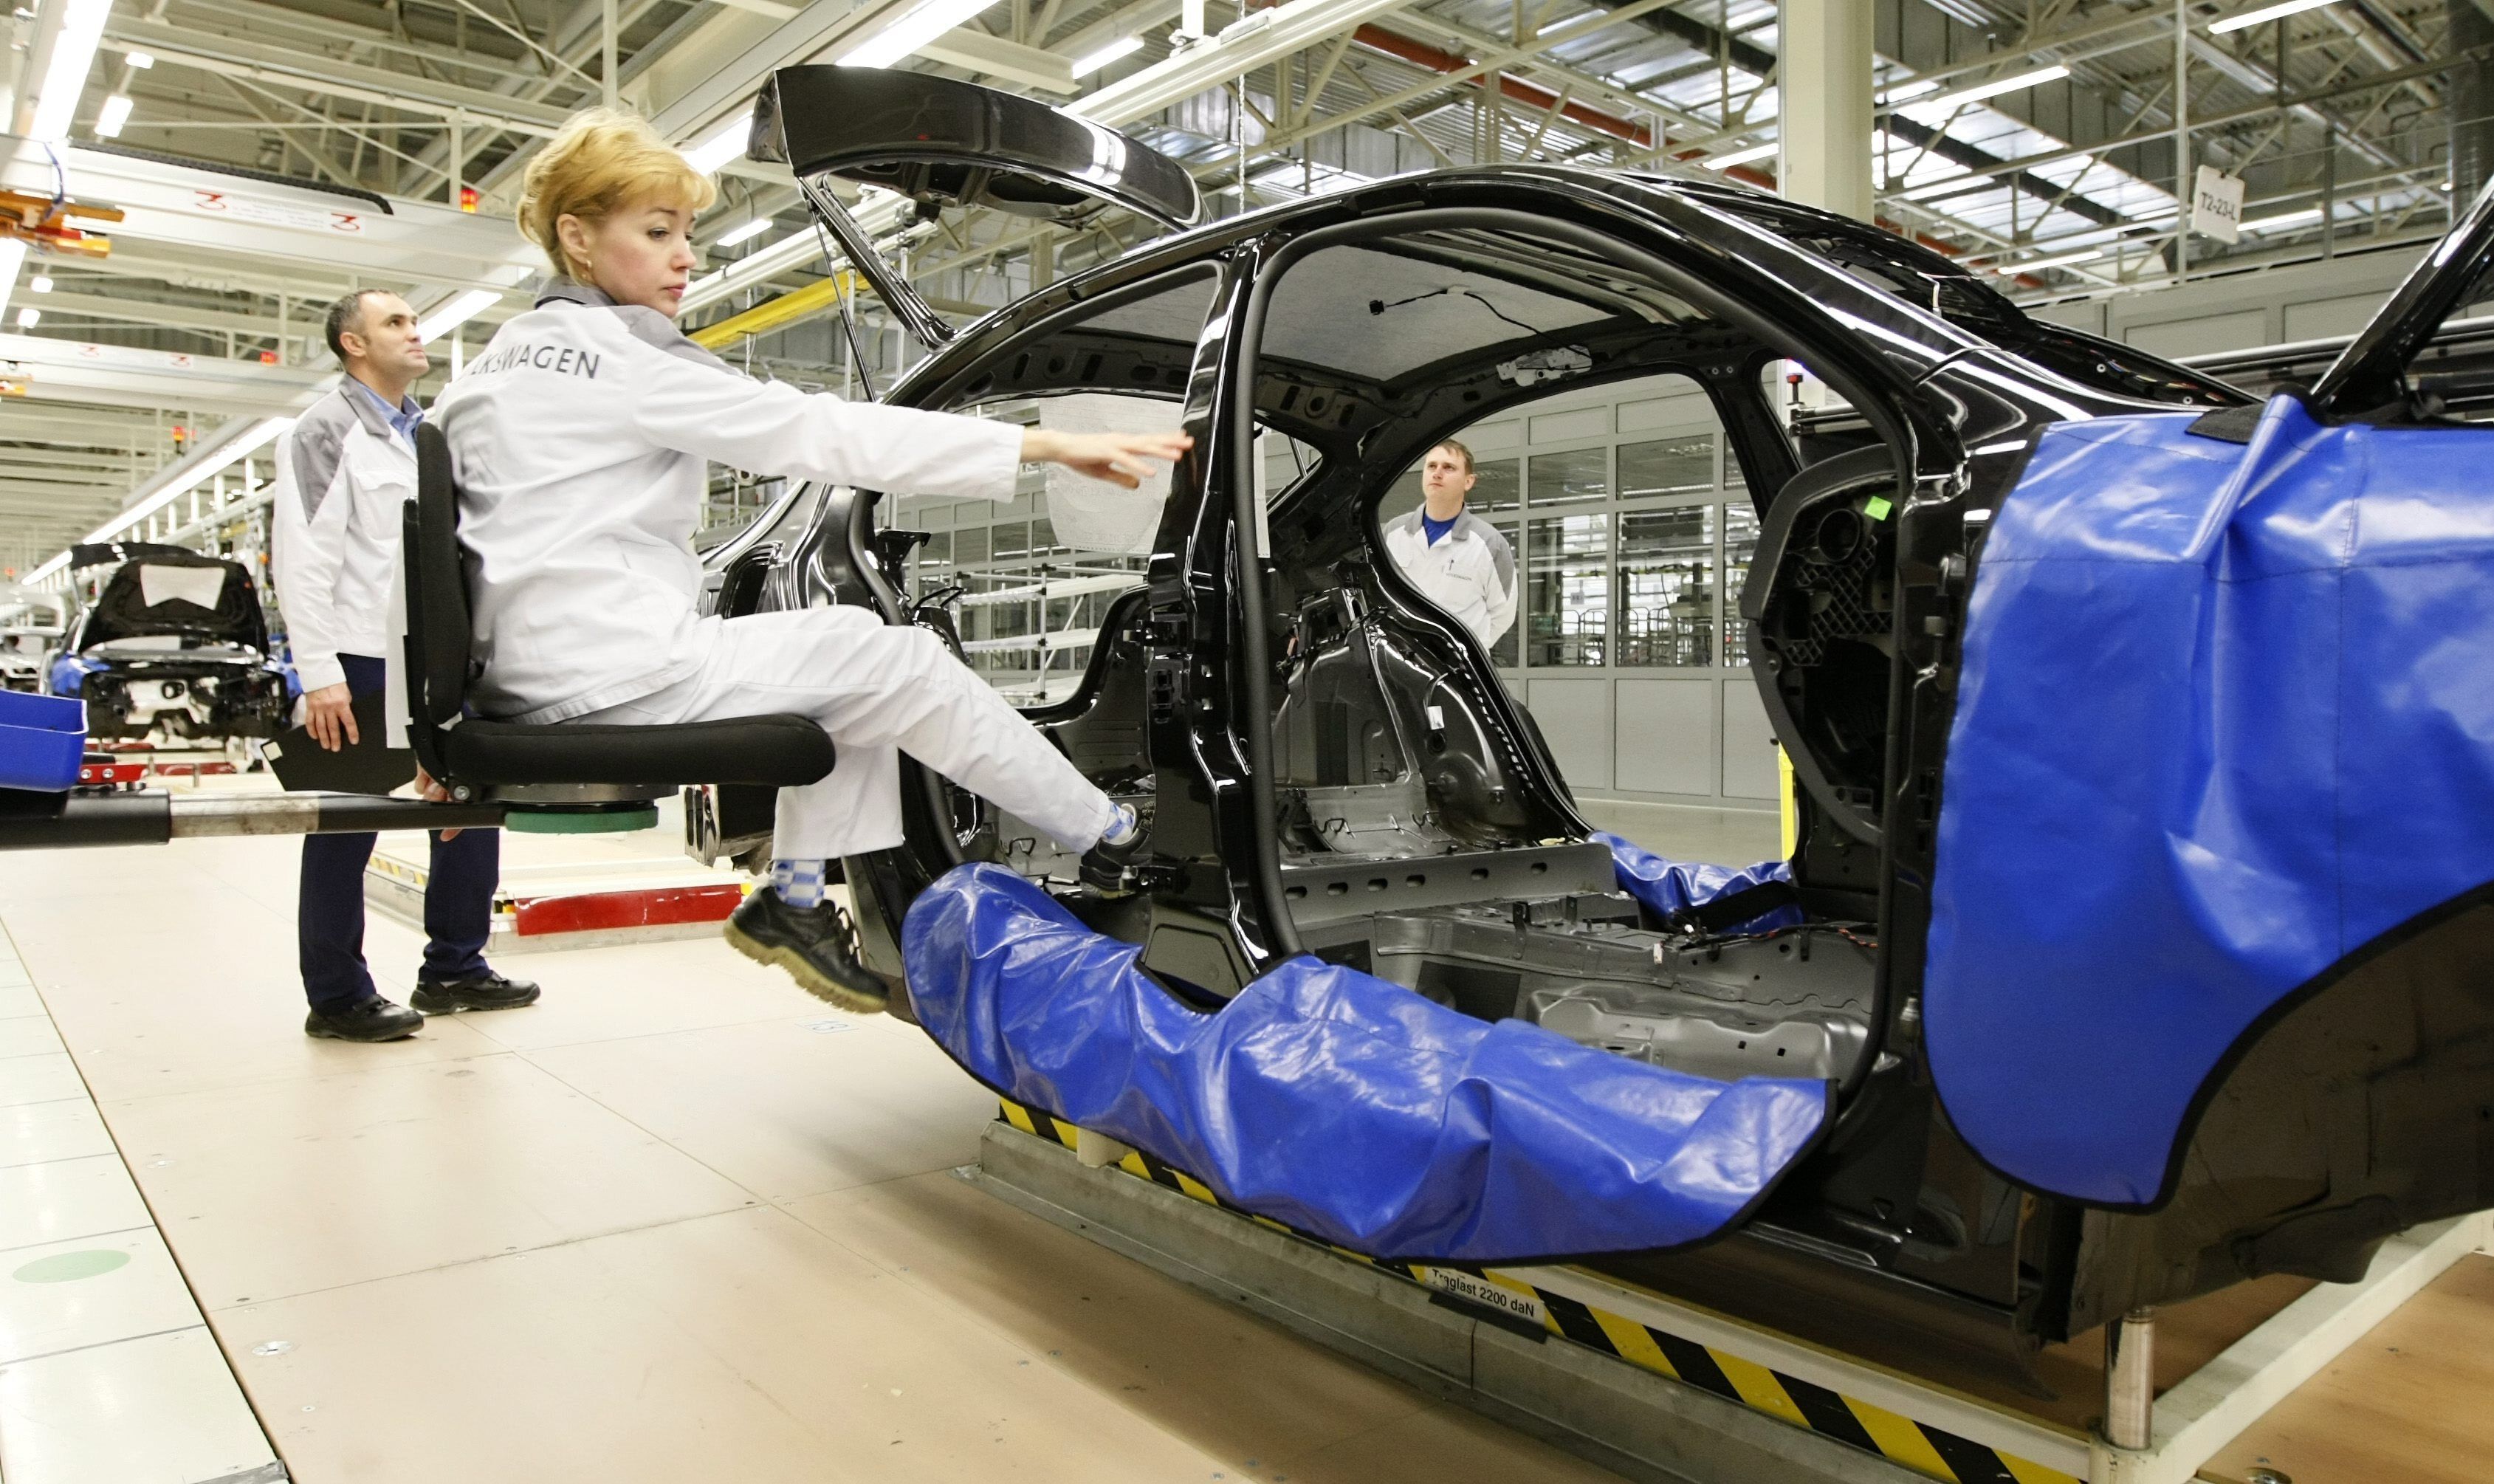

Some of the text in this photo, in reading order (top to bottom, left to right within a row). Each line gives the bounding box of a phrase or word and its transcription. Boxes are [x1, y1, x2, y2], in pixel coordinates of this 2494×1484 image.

[2200, 191, 2236, 220] T2-23-L
[1432, 1268, 1534, 1317] Taglast 2200 daN
